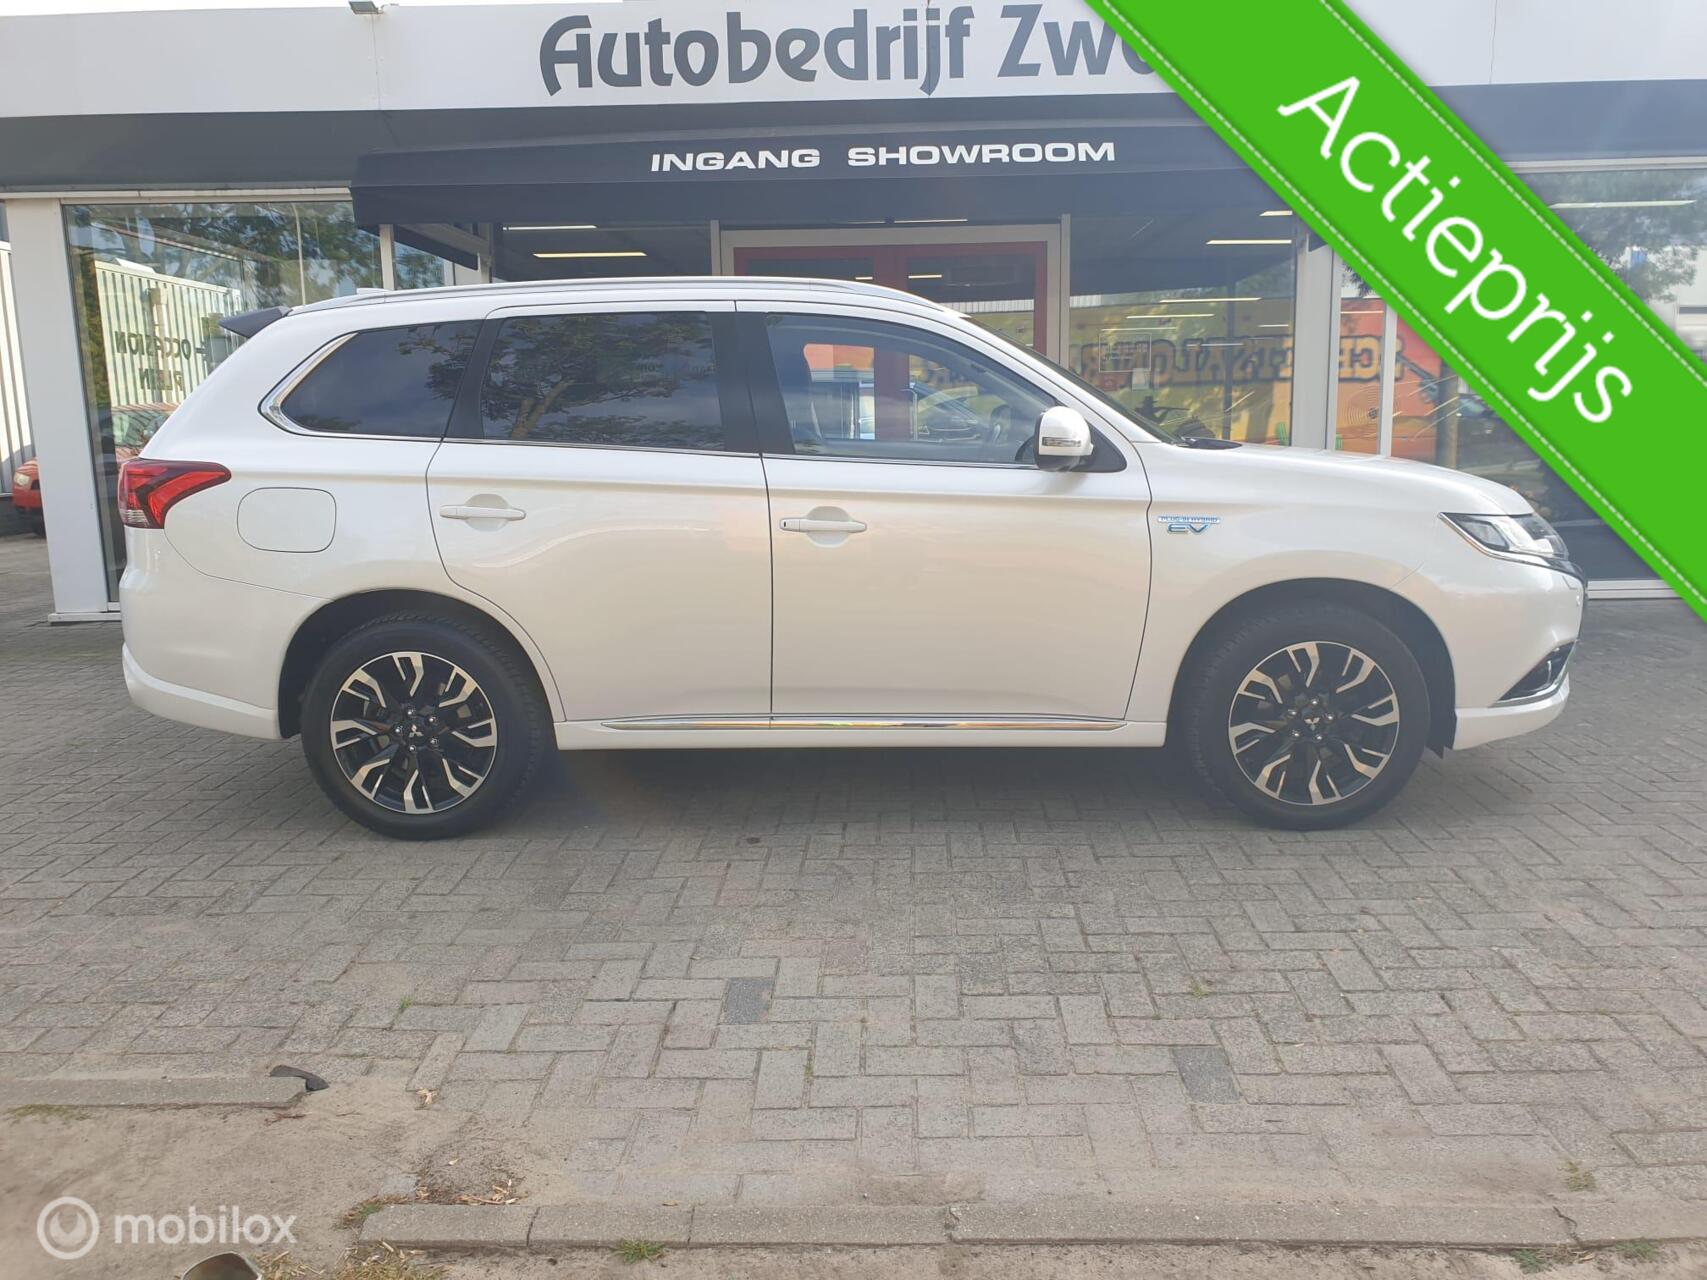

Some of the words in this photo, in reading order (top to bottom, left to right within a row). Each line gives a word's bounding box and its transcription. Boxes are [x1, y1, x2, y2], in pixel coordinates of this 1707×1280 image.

[539, 7, 974, 97] Autobedrijf
[651, 149, 820, 172] INGANG
[848, 142, 1116, 166] SHOWROOM
[1168, 523, 1209, 533] EV
